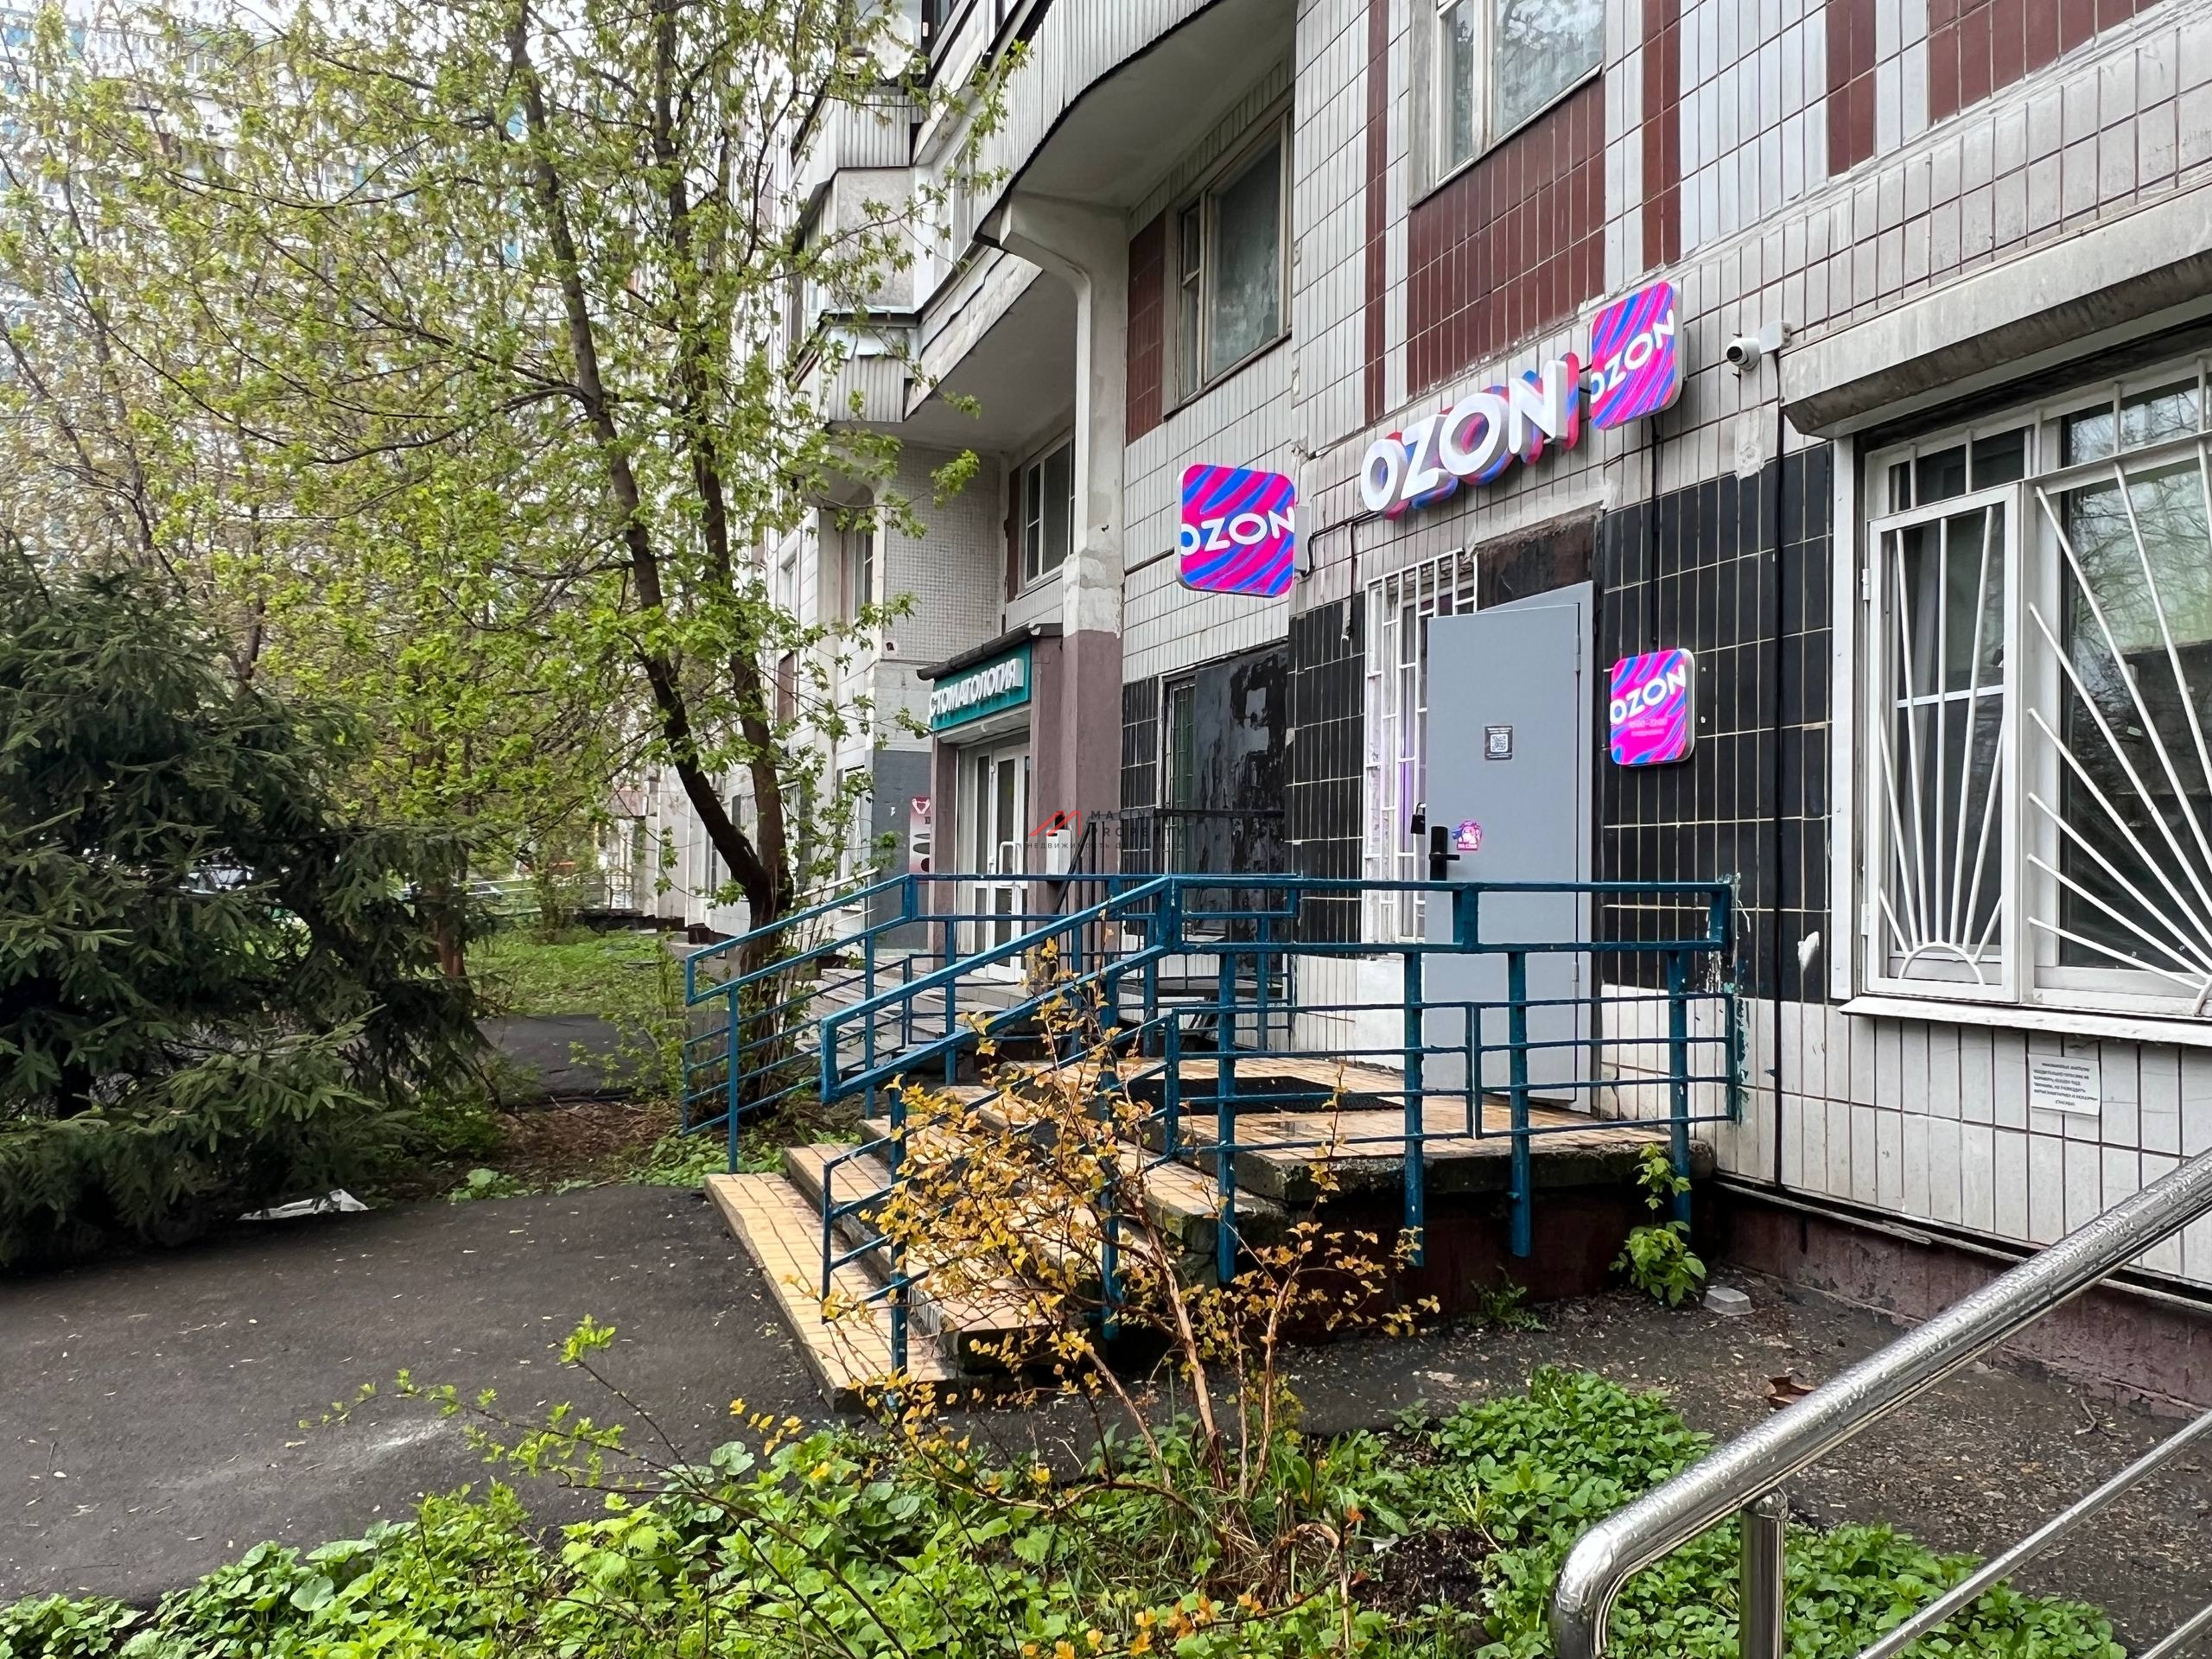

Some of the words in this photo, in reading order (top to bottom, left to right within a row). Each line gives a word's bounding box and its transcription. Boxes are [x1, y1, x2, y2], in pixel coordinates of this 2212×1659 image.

[1591, 309, 1675, 404] OZON
[1360, 359, 1569, 512] OZON
[1180, 505, 1295, 556] OZON
[929, 658, 1020, 717] СТОМАТОЛОГИЯ
[1610, 664, 1686, 725] OZON
